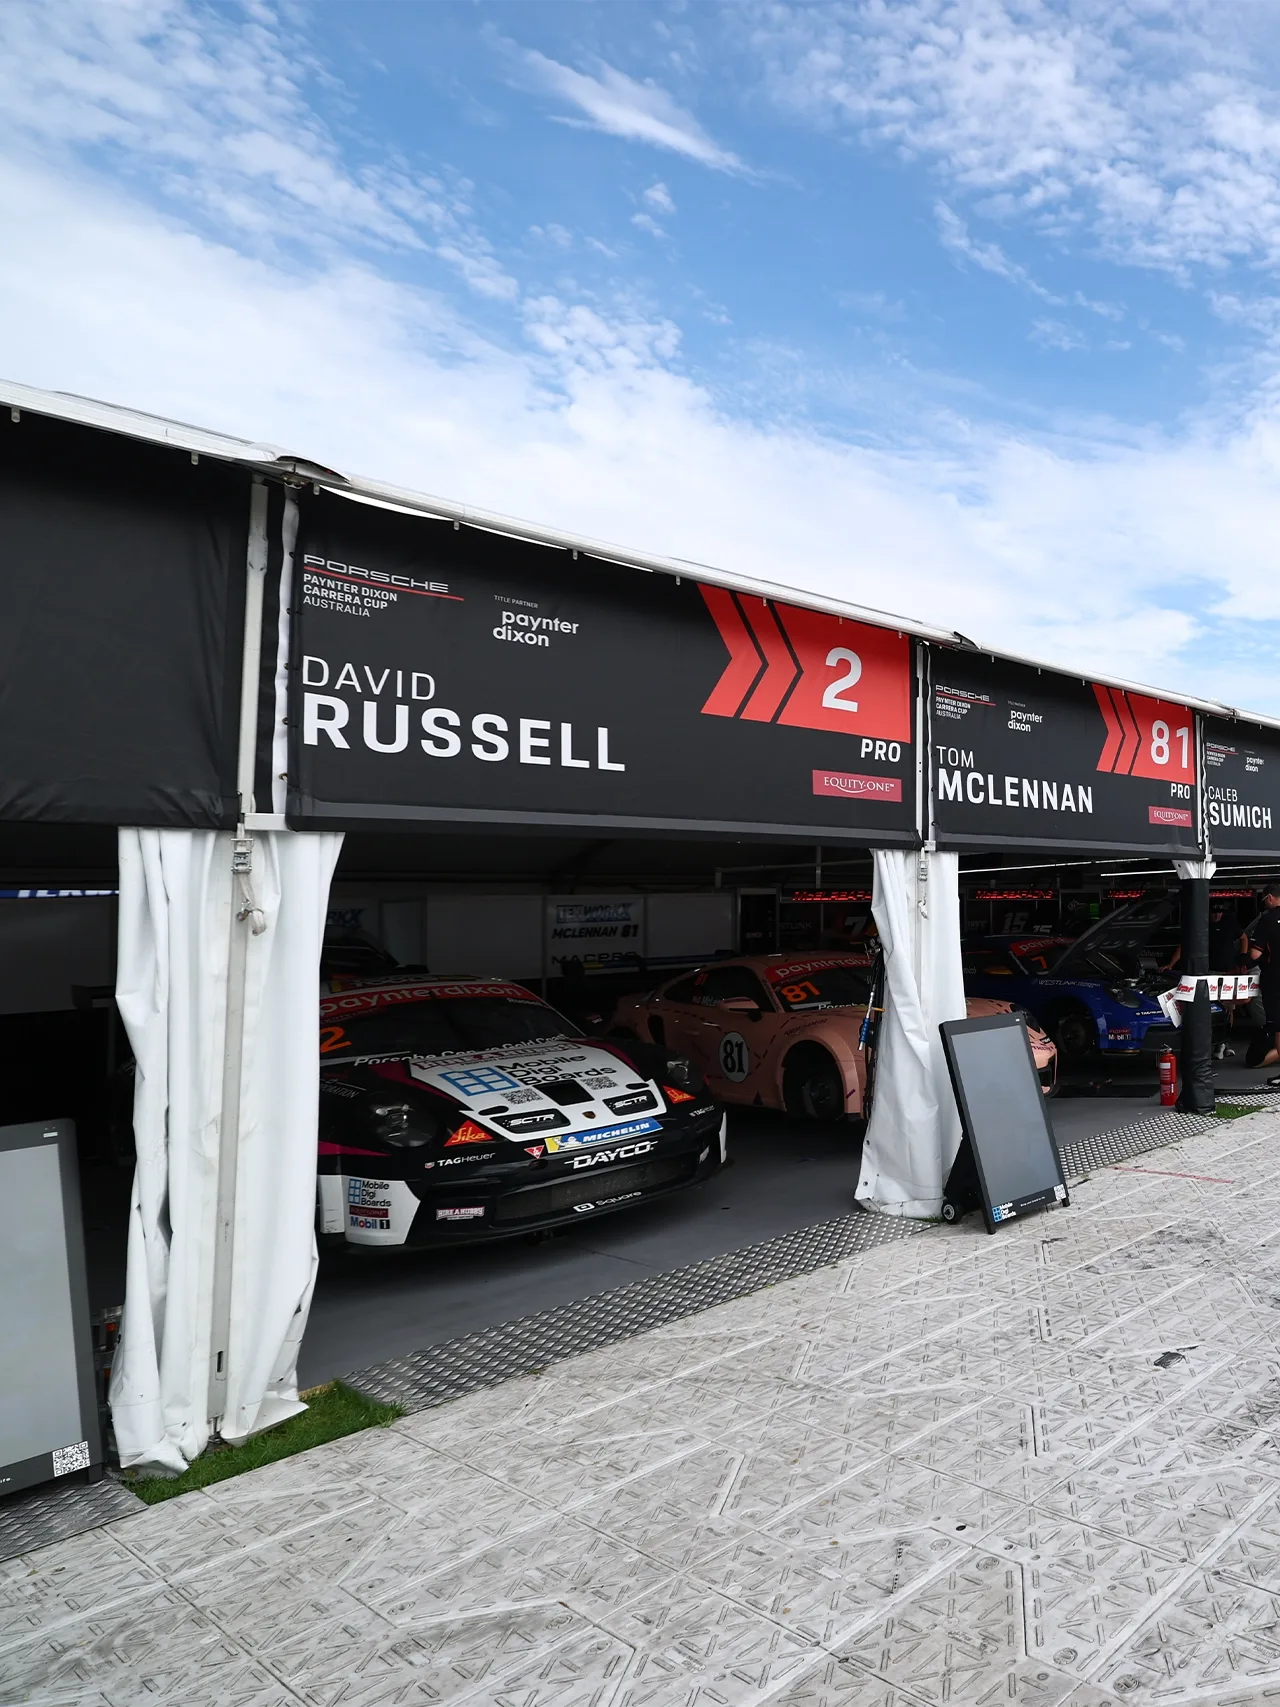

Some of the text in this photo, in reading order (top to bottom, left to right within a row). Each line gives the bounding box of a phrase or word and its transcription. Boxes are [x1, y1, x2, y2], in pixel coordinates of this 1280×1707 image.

[303, 554, 450, 593] PORSCHE
[303, 573, 398, 602] PAYNTER DIXON
[303, 584, 389, 610] CARRERA CUP
[303, 595, 371, 618] AUSTRALIA
[494, 594, 539, 609] TITLE PARTNER
[501, 610, 580, 635] paynter
[493, 625, 550, 647] dixon
[302, 655, 436, 701] DAVID
[821, 646, 863, 713] 2
[935, 684, 990, 702] PORSCHE
[935, 702, 968, 714] CARRERA CUP
[935, 709, 963, 721] AUSTRALIA
[1007, 719, 1031, 733] dixon
[1010, 710, 1043, 726] paynter
[303, 692, 626, 772] RUSSELL
[860, 738, 901, 763] PRO
[1151, 719, 1189, 769] 81
[1206, 742, 1236, 753] PORSCHE
[936, 745, 975, 769] TOM
[1246, 756, 1265, 767] paynter
[1244, 764, 1259, 773] dixon
[938, 768, 1093, 814] MCLENNAN
[1170, 783, 1191, 800] PRO
[1208, 786, 1238, 802] CALEB
[1208, 802, 1272, 830] SUMICH
[551, 924, 640, 940] MCLENNAN 81
[780, 980, 822, 1003] 81
[319, 1025, 352, 1054] 2
[495, 1055, 587, 1073] Mobile
[723, 1039, 745, 1073] 81
[507, 1064, 564, 1079] Digi
[517, 1066, 618, 1087] Boards
[612, 1094, 648, 1109] SCTR
[509, 1112, 555, 1128] SCTR
[452, 1123, 486, 1143] Sika
[582, 1121, 650, 1144] MICHELIN
[573, 1145, 651, 1170] DAYCO
[361, 1180, 390, 1191] Mobile
[361, 1189, 376, 1200] Digi
[360, 1198, 392, 1208] Boards
[595, 1190, 643, 1207] square
[350, 1216, 390, 1230] Mobil 1
